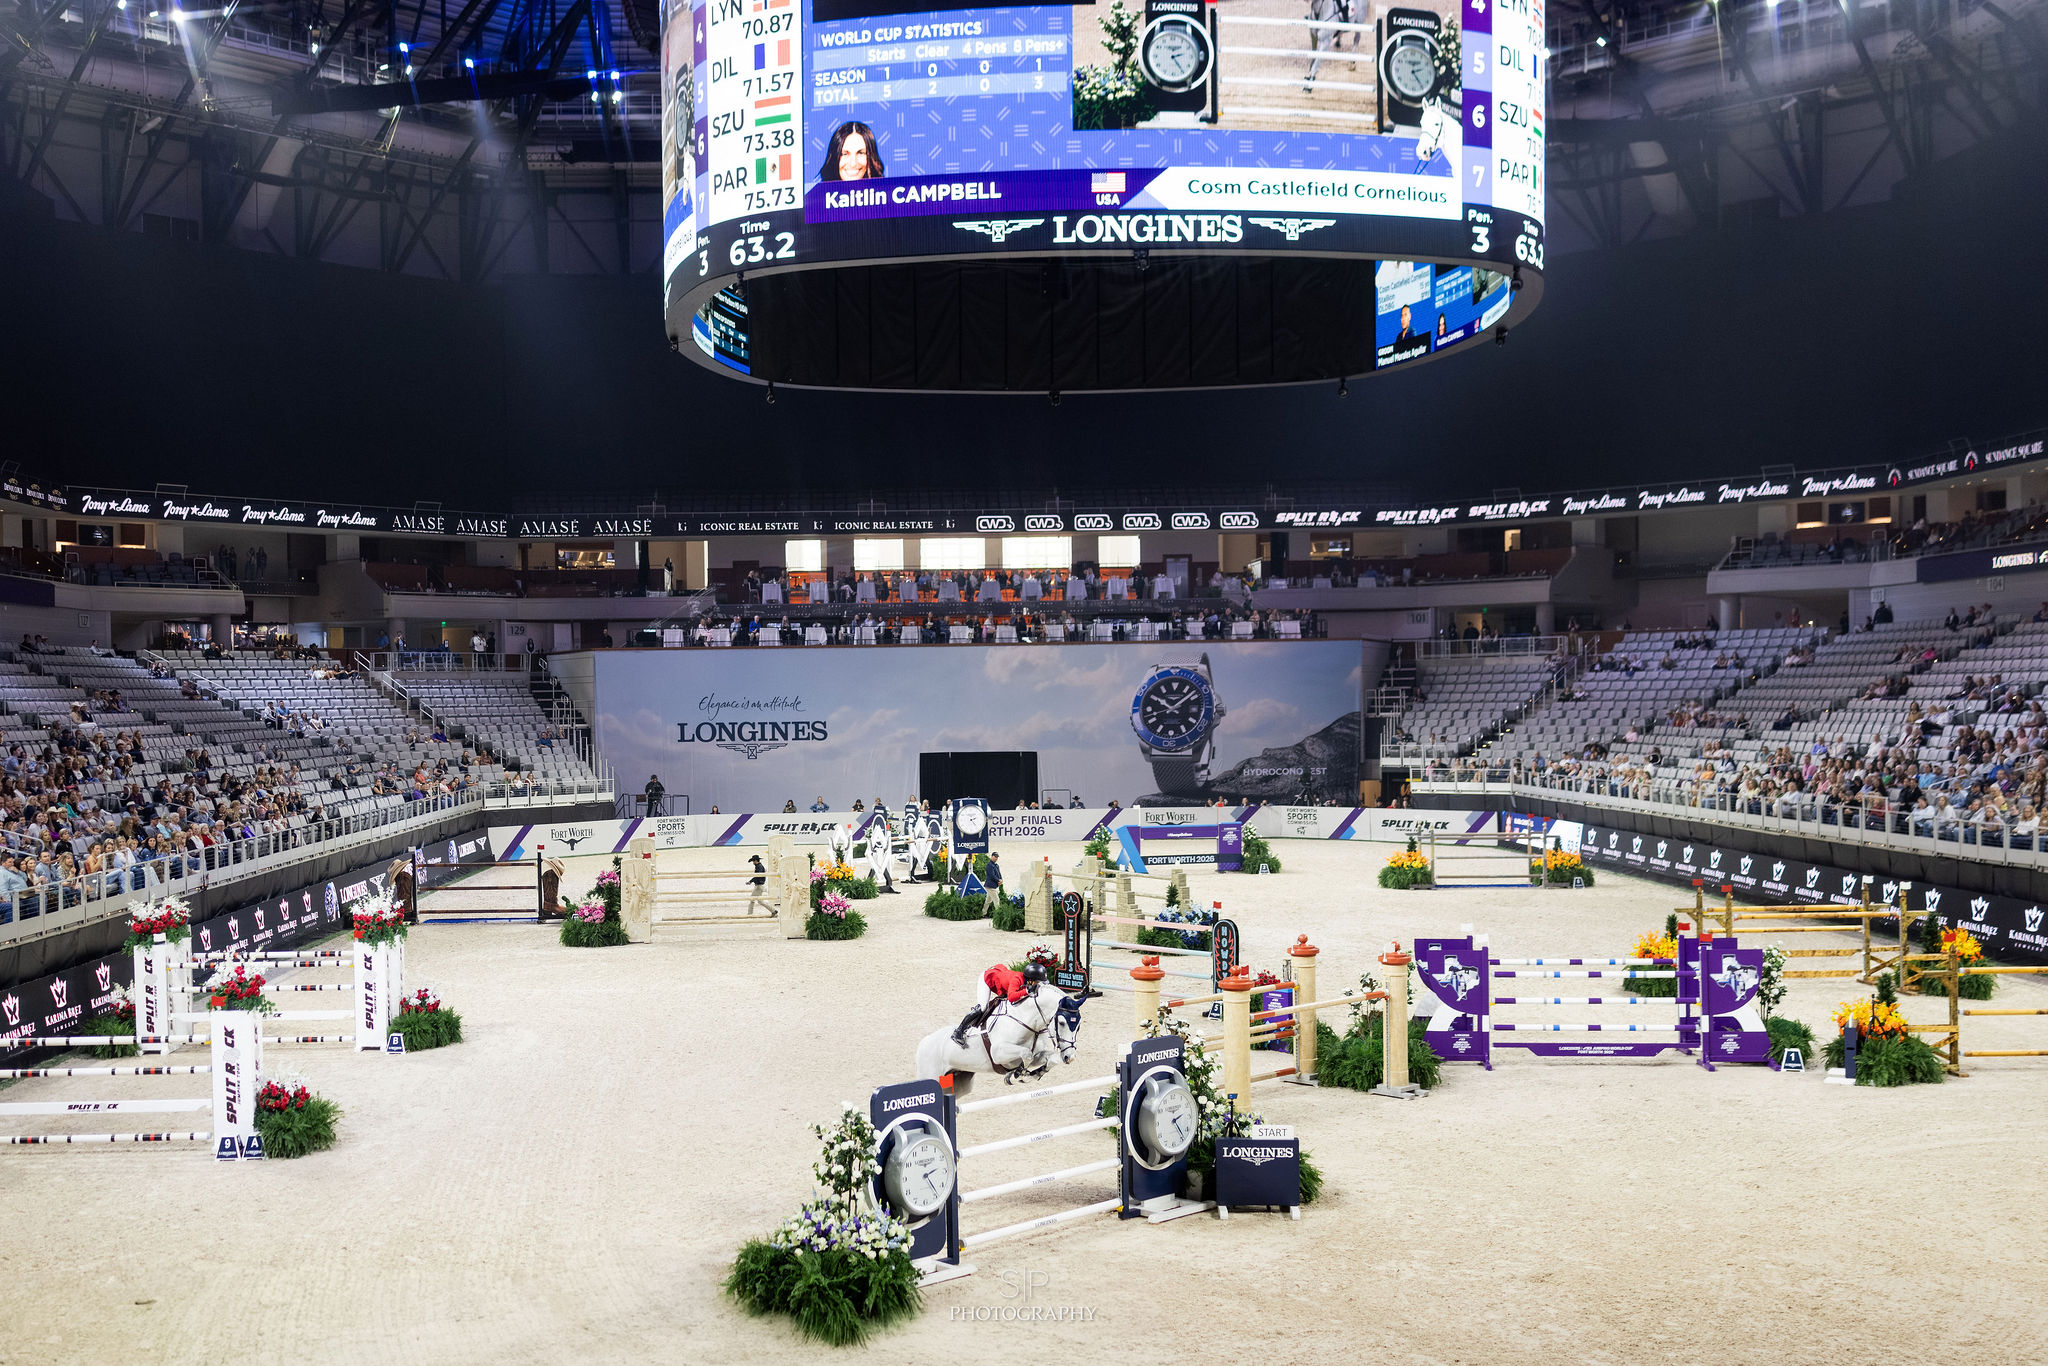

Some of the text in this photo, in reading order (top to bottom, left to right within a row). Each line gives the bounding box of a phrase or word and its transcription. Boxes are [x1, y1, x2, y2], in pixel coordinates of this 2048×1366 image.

[712, 0, 742, 26] LYN
[1151, 2, 1198, 13] LONGINES
[743, 13, 793, 39] 70.87
[1392, 17, 1436, 29] LONGINES
[696, 22, 704, 44] 4
[821, 22, 982, 47] WORLD CUP STATISTICS
[868, 38, 1063, 63] Starts Clear 4 Pens 8 Pens+
[1500, 45, 1524, 72] DIL
[712, 56, 738, 84] DIL
[1473, 51, 1485, 74] 5
[815, 58, 1042, 87] SEASON 1 0 0 1
[697, 81, 704, 104] 5
[743, 72, 794, 97] 71.57
[815, 75, 1043, 104] TOTAL 5 2 0 3
[712, 109, 744, 138] SZU
[1472, 104, 1486, 128] 6
[1499, 101, 1528, 128] SZU
[697, 133, 705, 155] 6
[744, 129, 794, 153] 73.38
[1472, 165, 1485, 188] 7
[1500, 158, 1529, 184] PAR
[713, 167, 747, 195] PAR
[745, 187, 795, 210] 75.73
[825, 182, 1002, 209] Kaitlin CAMPBELL
[1095, 194, 1120, 206] USA
[1188, 179, 1447, 203] Cosm Castlefield Cornelious
[698, 192, 705, 213] 7
[740, 221, 770, 234] Time
[1053, 215, 1243, 243] LONGINES
[730, 232, 796, 266] 63.2
[1471, 226, 1490, 253] 3
[699, 250, 709, 276] 3
[1718, 480, 1789, 503] Tony Lama
[1802, 473, 1876, 497] Tony Lama
[82, 495, 150, 515] Tony Lama
[163, 501, 230, 520] Tony Lama
[1468, 503, 1508, 517] SPLIT
[700, 522, 799, 531] ICONIC REAL ESTATE
[834, 521, 933, 530] ICONIC REAL ESTATE
[979, 518, 1010, 530] CWD
[1028, 517, 1059, 529] CWD
[1174, 515, 1206, 527] CWD
[1223, 514, 1254, 526] CWD
[1275, 512, 1317, 523] SPLIT
[1992, 552, 2034, 569] LONGINES
[1411, 615, 1426, 624] 101
[510, 625, 525, 635] 129
[698, 693, 807, 721] Elegance is an attitude
[677, 720, 828, 743] LONGINES
[992, 815, 1062, 825] CUP FINALS
[1145, 811, 1195, 822] FORT WORTH
[1287, 812, 1317, 821] SPORTS
[1381, 819, 1413, 828] SPLIT
[550, 827, 593, 839] FORT WORTH
[657, 822, 685, 832] SPORTS
[763, 823, 799, 832] SPLIT
[989, 827, 1045, 837] RTH 2026
[1148, 855, 1215, 865] FORT WORTH 2026
[365, 993, 374, 1030] SPLIT
[392, 1037, 399, 1045] B
[1137, 1048, 1179, 1064] LONGINES
[1789, 1053, 1795, 1061] 1
[225, 1078, 237, 1124] SPLIT
[883, 1093, 936, 1112] LONGINES
[1030, 1089, 1053, 1099] LONGINES
[1258, 1128, 1287, 1137] START
[224, 1138, 231, 1149] 9
[250, 1137, 259, 1148] A
[1222, 1147, 1294, 1158] LONGINES
[1035, 1218, 1057, 1228] LONGINES
